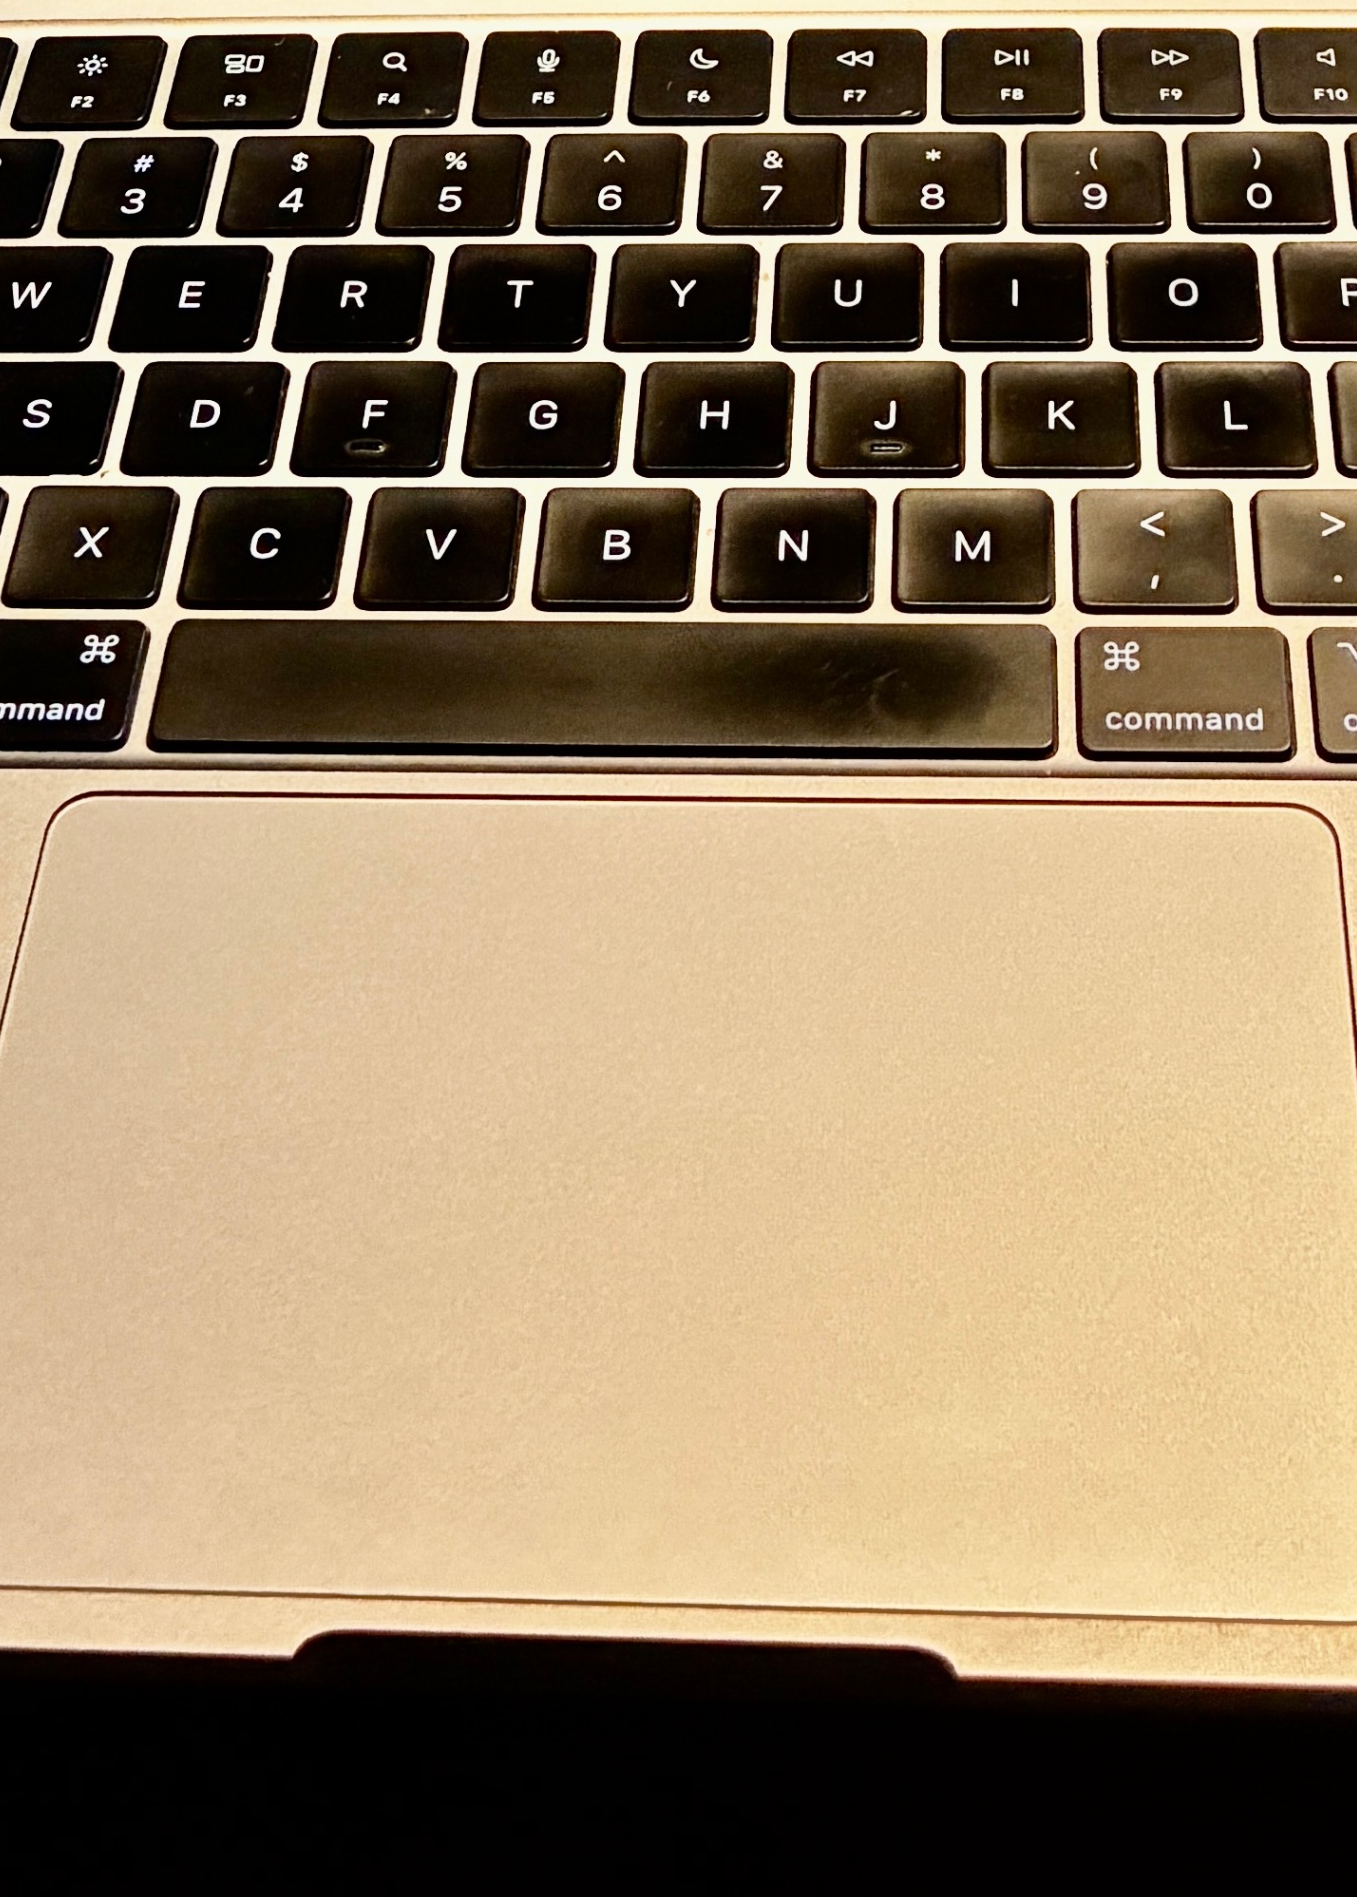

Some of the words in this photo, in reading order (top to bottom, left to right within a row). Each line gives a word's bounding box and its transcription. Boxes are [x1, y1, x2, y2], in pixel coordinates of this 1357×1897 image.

[11, 281, 53, 309] W
[178, 280, 206, 309] E
[340, 280, 368, 308] R
[506, 279, 534, 309] T
[670, 279, 697, 308] Y
[834, 279, 863, 308] U
[1011, 278, 1019, 307] I
[1168, 278, 1199, 307] O
[22, 398, 53, 429] S
[189, 399, 221, 429] D
[362, 399, 389, 429] F
[528, 399, 558, 430] G
[699, 399, 730, 430] H
[873, 400, 897, 430] J
[1048, 400, 1076, 430] K
[1223, 400, 1249, 431] L
[1105, 707, 1264, 731] command
